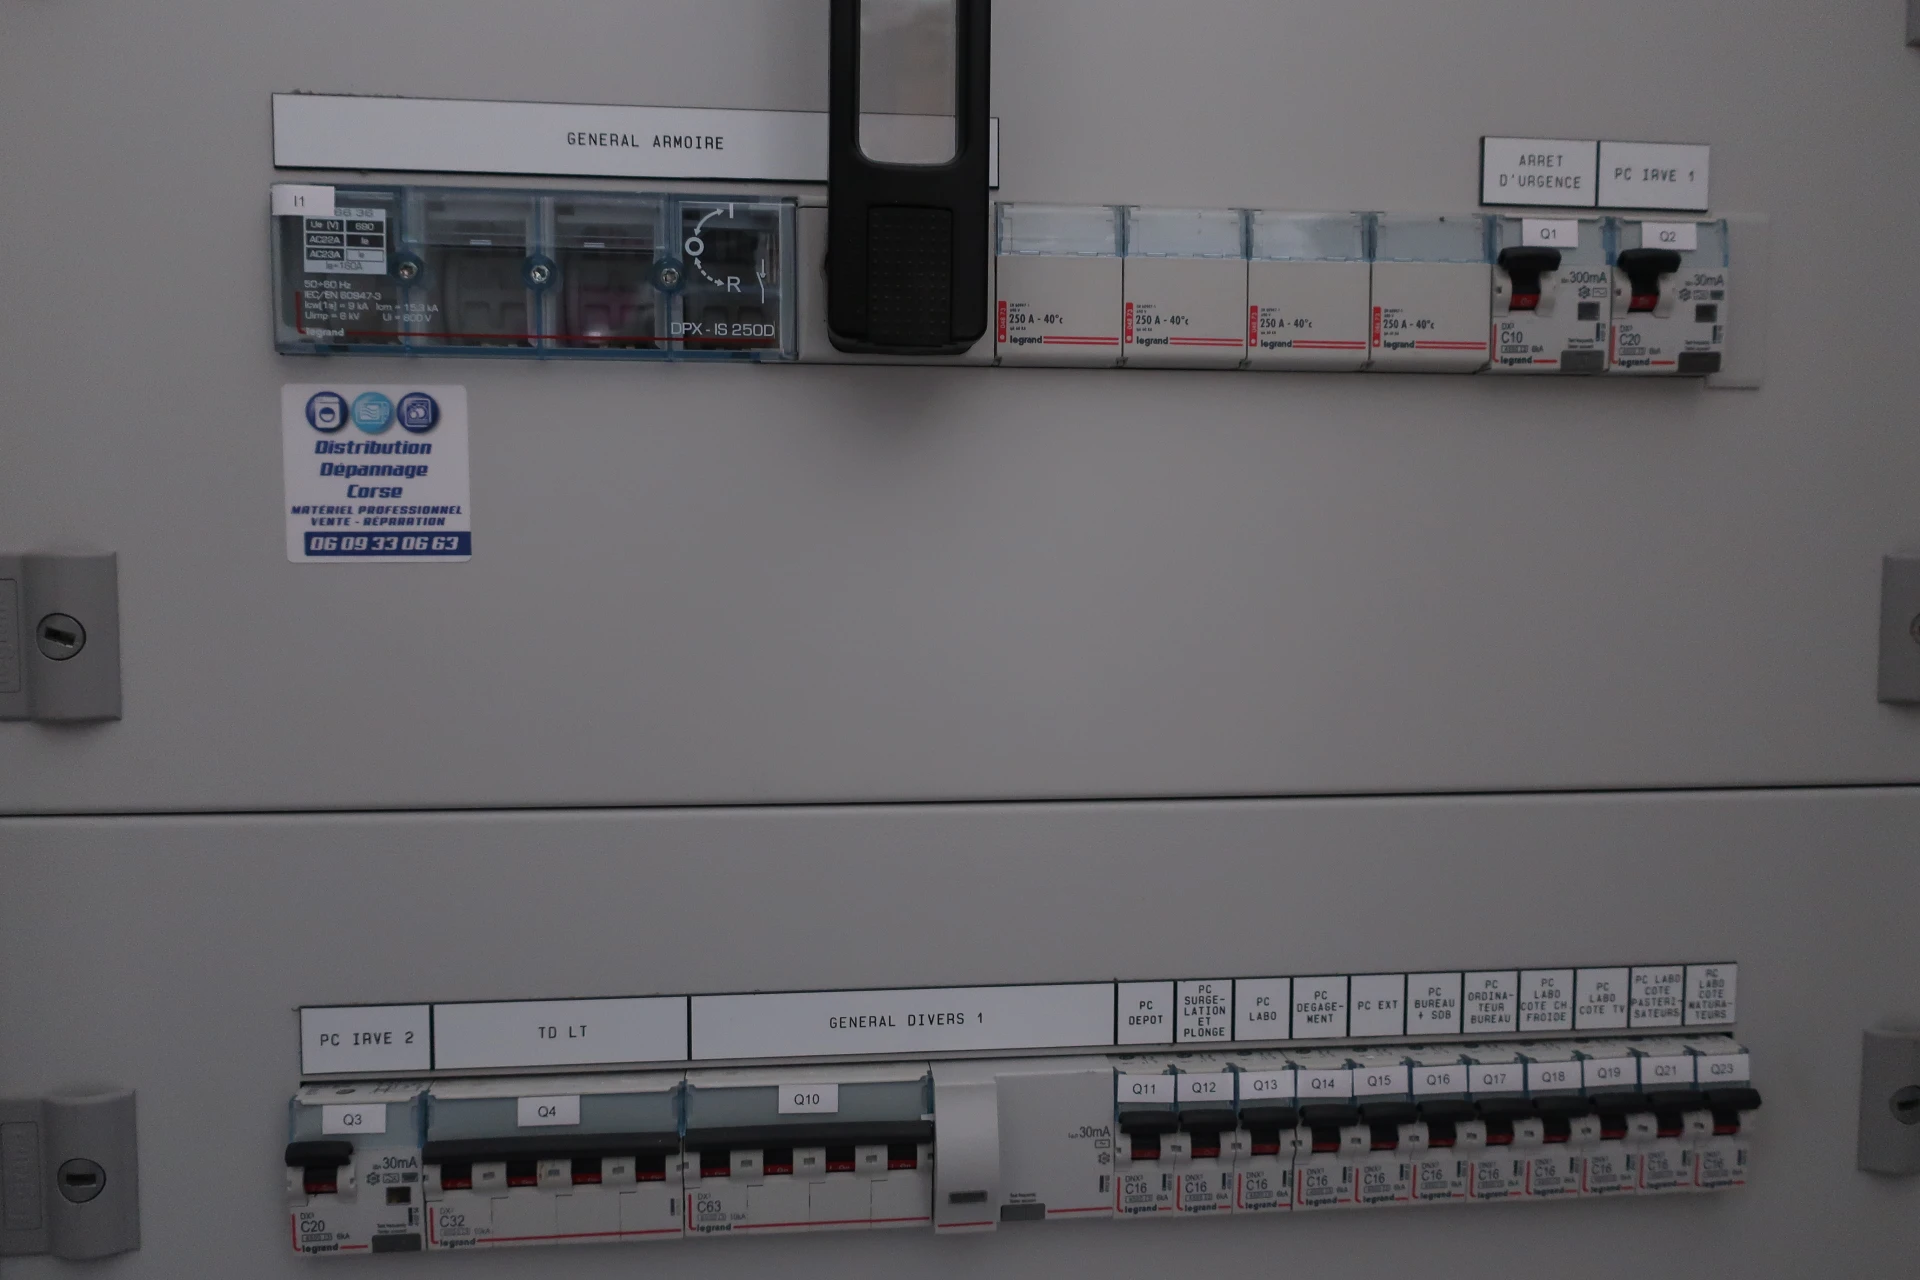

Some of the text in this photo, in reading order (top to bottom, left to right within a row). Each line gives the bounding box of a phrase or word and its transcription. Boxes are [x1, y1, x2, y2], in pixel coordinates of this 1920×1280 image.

[567, 132, 724, 150] GENERAL ARMOIRE
[1518, 154, 1564, 167] ARRET
[1614, 168, 1694, 182] PC IRVE 1
[1499, 173, 1582, 189] D'URGENCE
[355, 222, 375, 231] 690
[309, 235, 340, 244] AC22A
[1540, 228, 1557, 240] Q1
[1660, 230, 1676, 243] Q2
[309, 250, 341, 259] AC23A
[1570, 270, 1608, 284] 300mA
[1694, 274, 1724, 286] 30mA
[338, 280, 352, 288] Hz
[726, 276, 742, 292] R
[304, 291, 382, 300] IEC/EN 60947-3
[356, 302, 369, 310] kA
[348, 312, 360, 320] kV
[1009, 314, 1034, 324] 250 A
[1136, 315, 1161, 325] 250 A
[1260, 318, 1284, 328] 250 A
[1383, 319, 1408, 329] 250 A
[304, 328, 344, 338] legrand
[670, 322, 774, 337] DPX IS 250D
[1010, 335, 1042, 346] legrand
[1136, 336, 1168, 346] legrand
[1501, 331, 1523, 344] C10
[1620, 333, 1641, 346] C20
[1260, 340, 1292, 350] legrand
[1384, 340, 1415, 350] legrand
[1500, 356, 1532, 368] legrand
[1618, 358, 1650, 369] legrand
[314, 440, 432, 454] Distribution
[320, 462, 428, 479] Dépannage
[346, 484, 403, 498] Corse
[290, 504, 462, 515] MATÉRIEL PROFESSIONNEL
[311, 516, 446, 526] VENTE RÉPARATION
[310, 536, 460, 552] 06 09 33 06 63
[1541, 978, 1554, 988] PC
[1635, 973, 1681, 984] PC LABO
[1198, 984, 1212, 994] PC
[1485, 980, 1498, 989] PC
[1596, 982, 1610, 991] PC
[1314, 990, 1328, 1000] PC
[1428, 987, 1442, 996] PC
[1468, 990, 1515, 1002] ORDINA-
[1534, 989, 1561, 999] LABO
[1644, 986, 1671, 995] COTE
[1184, 995, 1226, 1005] SURGE-
[1256, 997, 1270, 1006] PC
[1414, 998, 1456, 1009] BUREAU
[1589, 993, 1616, 1003] LABO
[1139, 1000, 1153, 1010] PC
[1296, 1001, 1344, 1012] DEGAGE-
[1357, 1000, 1398, 1010] PC EXT
[1478, 1002, 1504, 1012] TEUR
[1520, 1000, 1547, 1011] COTE
[1579, 1004, 1626, 1015] COTE TV
[1184, 1006, 1226, 1016] LATION
[1432, 1010, 1452, 1020] SDB
[1634, 1008, 1680, 1018] SATEURS
[829, 1012, 983, 1029] GENERAL DIVERS 1
[1128, 1014, 1164, 1026] DEPOT
[1198, 1016, 1211, 1026] ET
[1248, 1012, 1277, 1022] LABO
[1306, 1014, 1334, 1024] MENT
[1470, 1014, 1511, 1024] BUREAU
[1526, 1012, 1567, 1022] FROIDE
[538, 1024, 588, 1038] TD LT
[1184, 1027, 1226, 1038] PLONGE
[320, 1031, 414, 1046] PC IRVE 2
[1598, 1068, 1622, 1079] Q19
[1654, 1065, 1677, 1076] Q21
[1710, 1063, 1734, 1074] Q23
[1367, 1075, 1392, 1087] Q15
[1426, 1074, 1450, 1086] Q16
[1483, 1074, 1506, 1085] Q17
[1542, 1071, 1566, 1082] Q18
[1132, 1084, 1156, 1095] Q11
[1192, 1082, 1216, 1094] Q12
[1253, 1080, 1278, 1091] Q13
[1311, 1078, 1335, 1090] Q14
[794, 1094, 820, 1106] Q10
[538, 1106, 557, 1118] Q4
[342, 1114, 362, 1126] Q3
[1079, 1126, 1110, 1138] 30mA
[382, 1156, 418, 1168] 30mA
[1478, 1168, 1500, 1180] C16
[1534, 1166, 1556, 1177] C16
[1591, 1164, 1612, 1174] C16
[1364, 1172, 1385, 1184] C16
[1421, 1169, 1443, 1181] C16
[1246, 1178, 1268, 1190] C16
[1306, 1175, 1328, 1187] C16
[1124, 1182, 1148, 1194] C16
[1185, 1181, 1207, 1194] C16
[1306, 1196, 1337, 1206] legrand
[1364, 1194, 1395, 1204] legrand
[1420, 1192, 1452, 1201] legrand
[697, 1200, 722, 1212] C63
[1124, 1204, 1158, 1214] legrand
[1184, 1203, 1217, 1212] legrand
[1246, 1201, 1277, 1210] legrand
[301, 1220, 326, 1232] C20
[440, 1215, 466, 1228] C32
[696, 1224, 732, 1232] legrand
[302, 1242, 338, 1254] legrand
[440, 1238, 476, 1248] legrand
